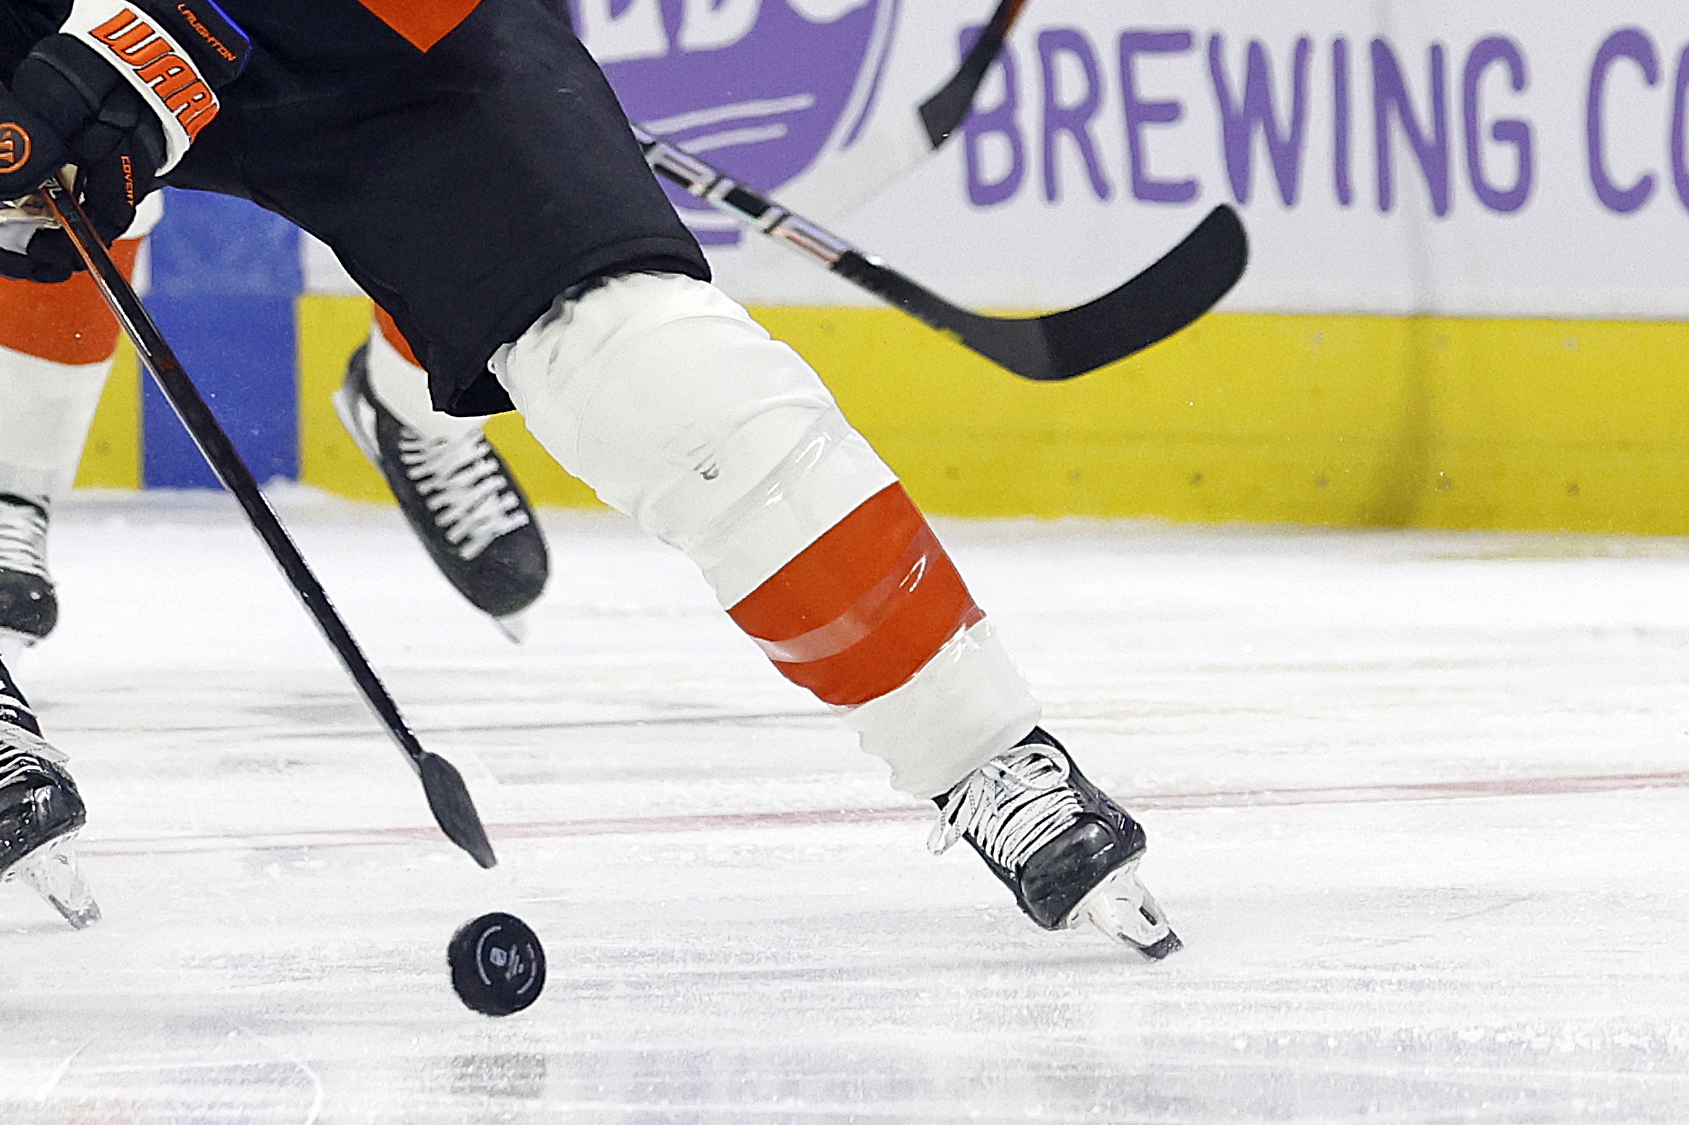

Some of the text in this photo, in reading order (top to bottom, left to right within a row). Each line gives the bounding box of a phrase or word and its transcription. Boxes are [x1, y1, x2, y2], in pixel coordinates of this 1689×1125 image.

[176, 2, 238, 62] LAUGHTON
[958, 25, 1689, 217] BREWING C
